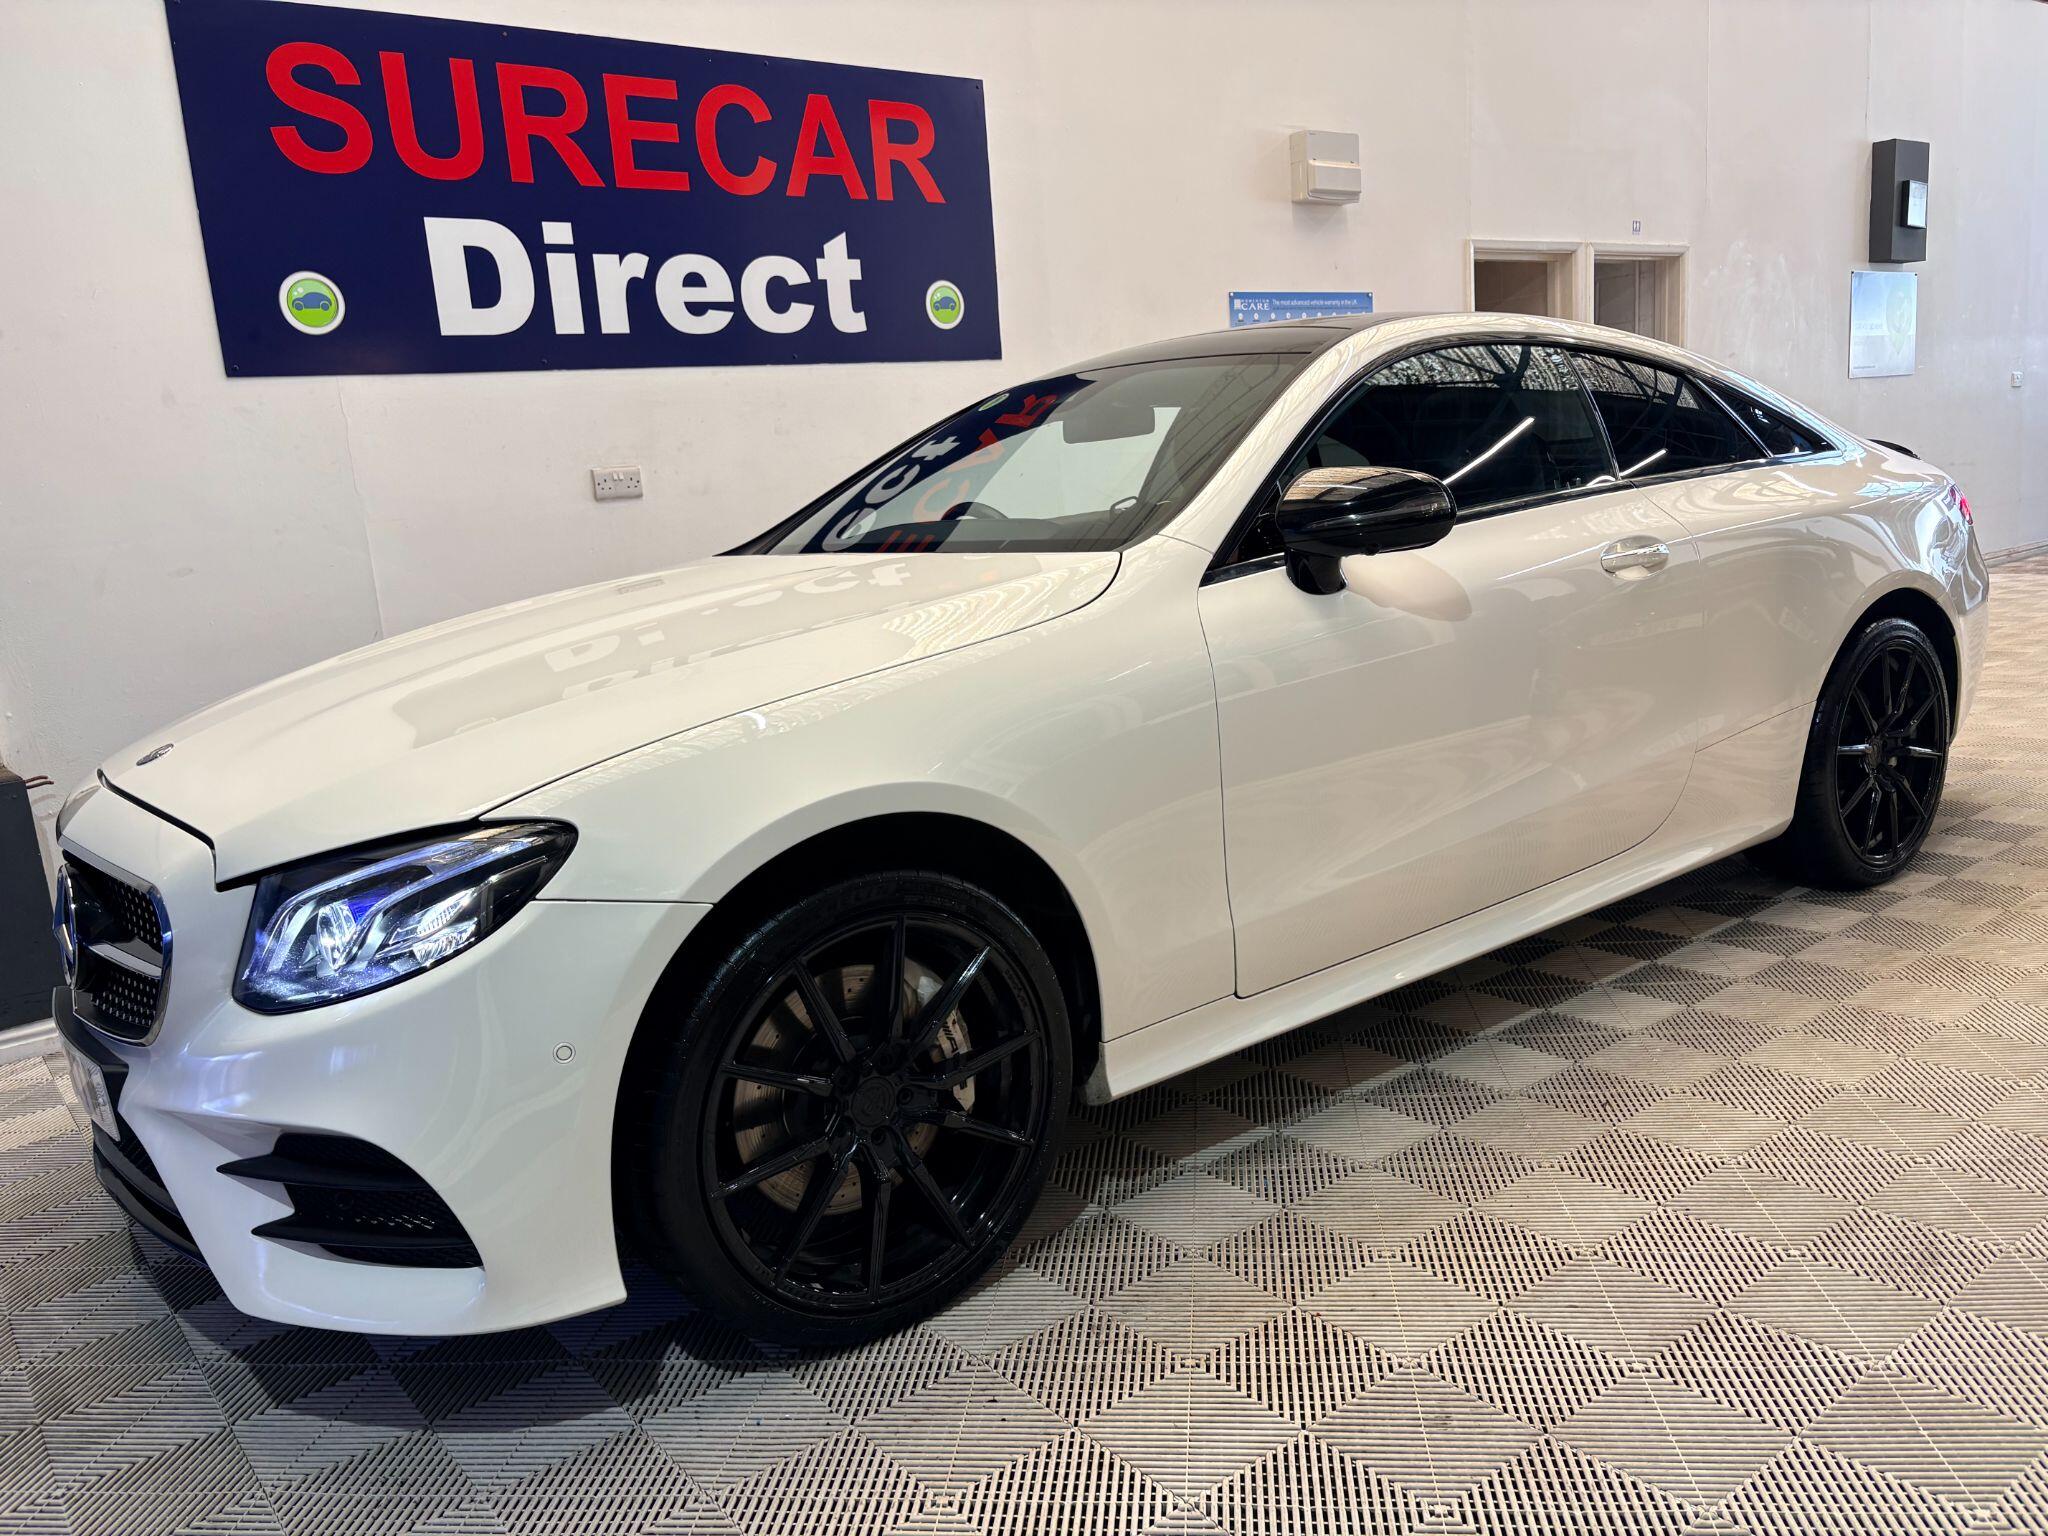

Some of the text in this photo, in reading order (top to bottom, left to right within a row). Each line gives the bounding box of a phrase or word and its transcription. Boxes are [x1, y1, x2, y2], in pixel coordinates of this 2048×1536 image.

[265, 41, 945, 203] SURECAR
[423, 216, 867, 336] Direct
[1241, 302, 1270, 310] CARE
